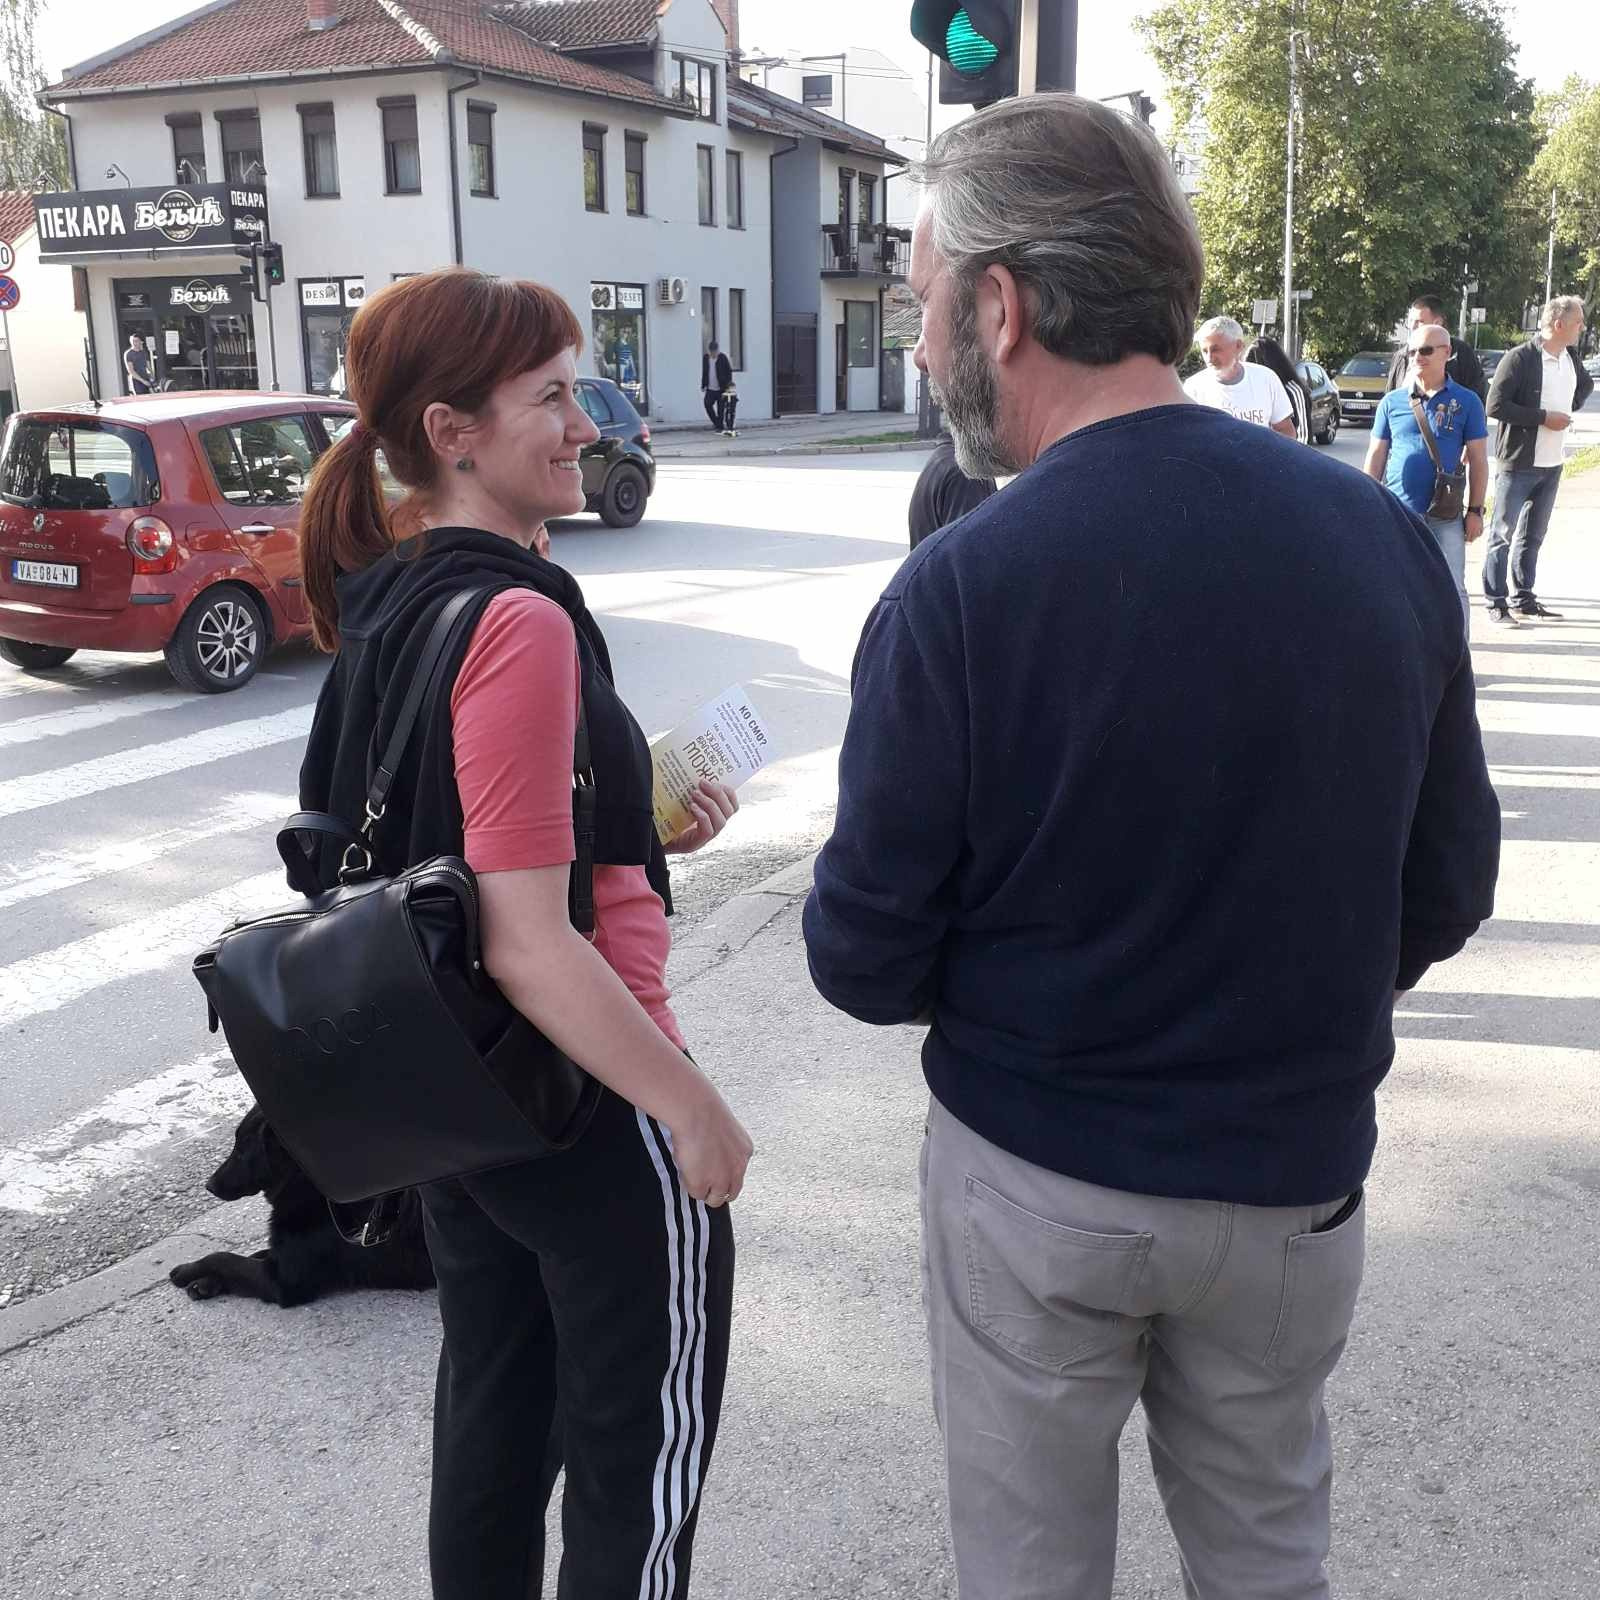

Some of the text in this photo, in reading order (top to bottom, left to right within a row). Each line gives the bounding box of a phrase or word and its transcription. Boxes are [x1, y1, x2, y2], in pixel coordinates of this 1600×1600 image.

[135, 198, 225, 230] Бељић
[231, 190, 265, 208] ПЕКАРА
[38, 204, 127, 239] ПЕКАРА
[171, 285, 231, 304] Бељић
[738, 705, 768, 746] КО СМО?
